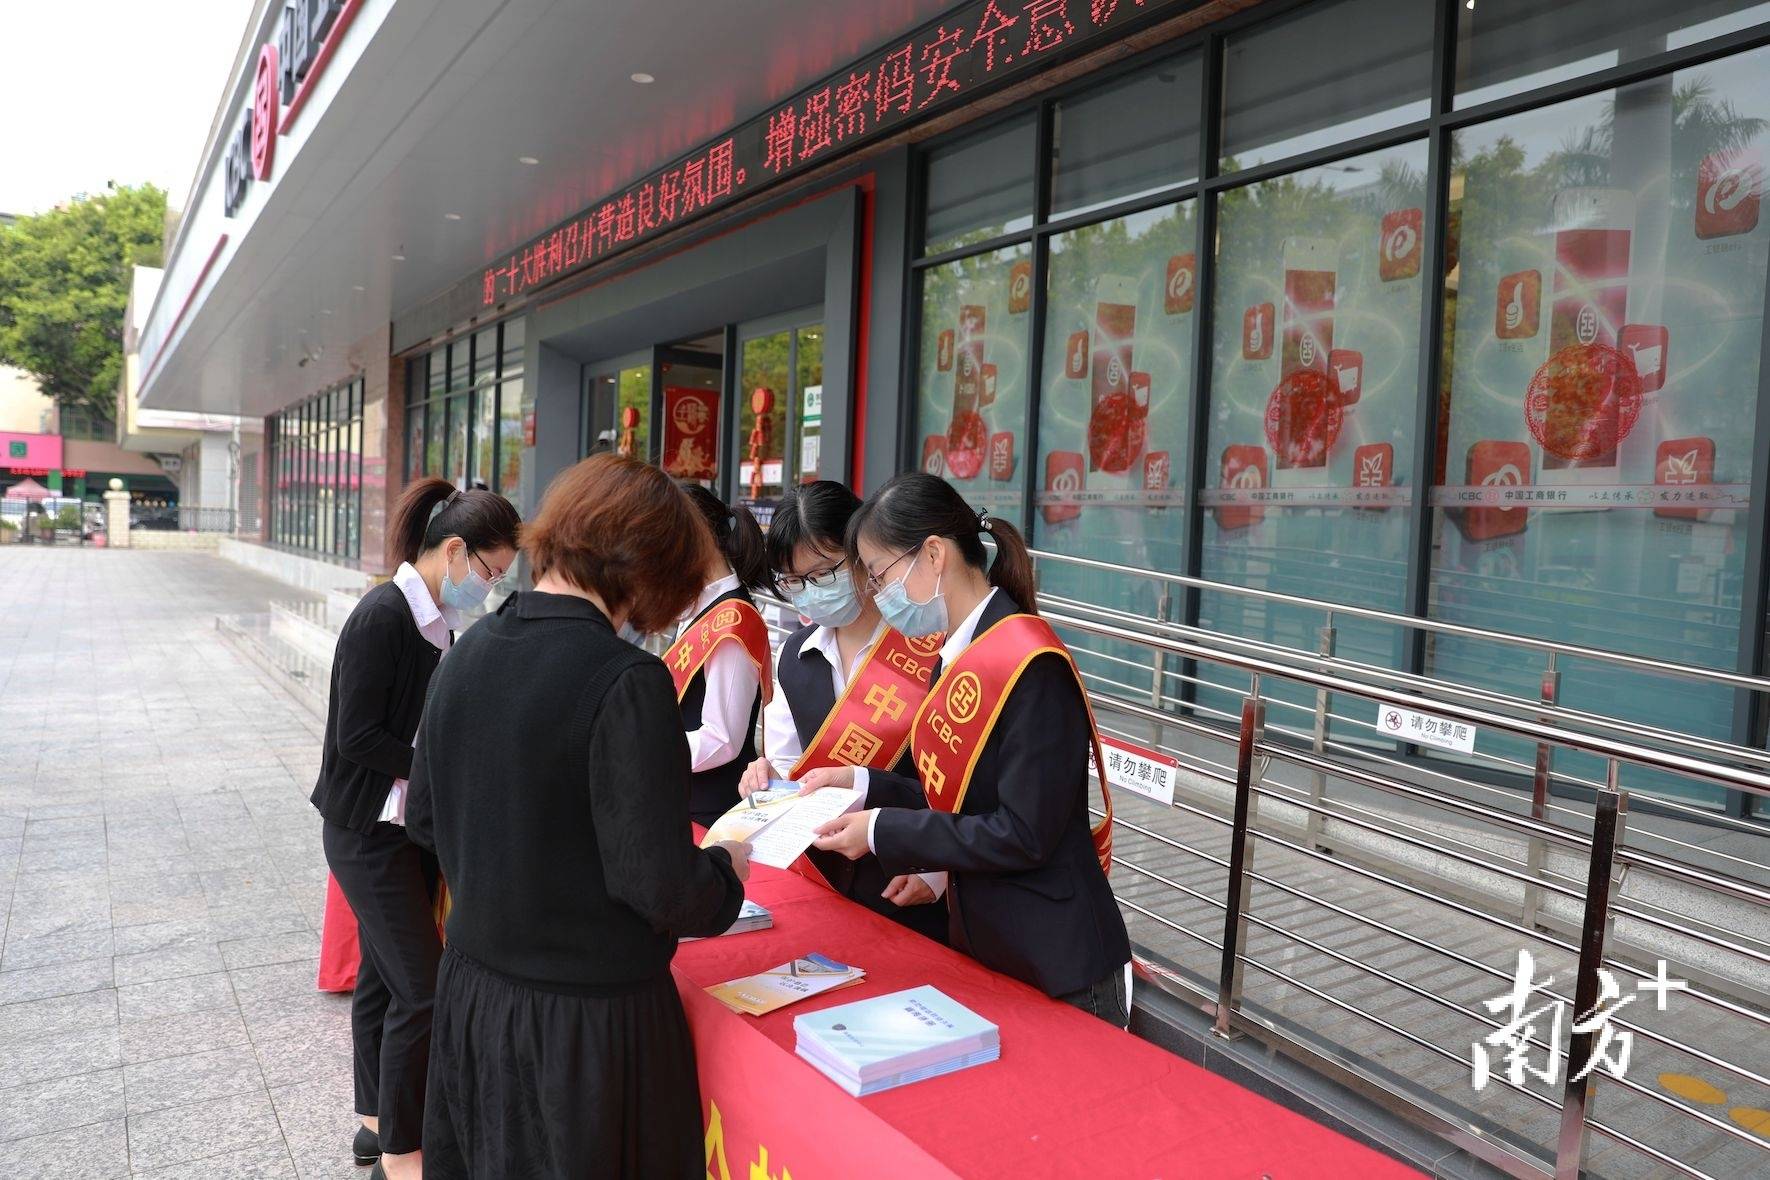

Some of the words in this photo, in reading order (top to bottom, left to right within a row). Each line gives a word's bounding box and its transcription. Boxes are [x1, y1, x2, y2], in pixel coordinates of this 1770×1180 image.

[1458, 490, 1482, 501] ICBC
[1504, 490, 1568, 501] 中国工商银行
[673, 641, 694, 673] 中
[885, 648, 932, 682] ICBC
[827, 682, 908, 767] 中国
[926, 708, 963, 755] ICBC
[1411, 714, 1468, 741] 请勿攀爬
[1421, 732, 1429, 740] No
[1429, 733, 1453, 746] Climbing
[918, 748, 947, 796] 中
[1108, 751, 1167, 788] 请勿攀爬
[1119, 775, 1128, 783] No
[1127, 777, 1152, 794] Climbing
